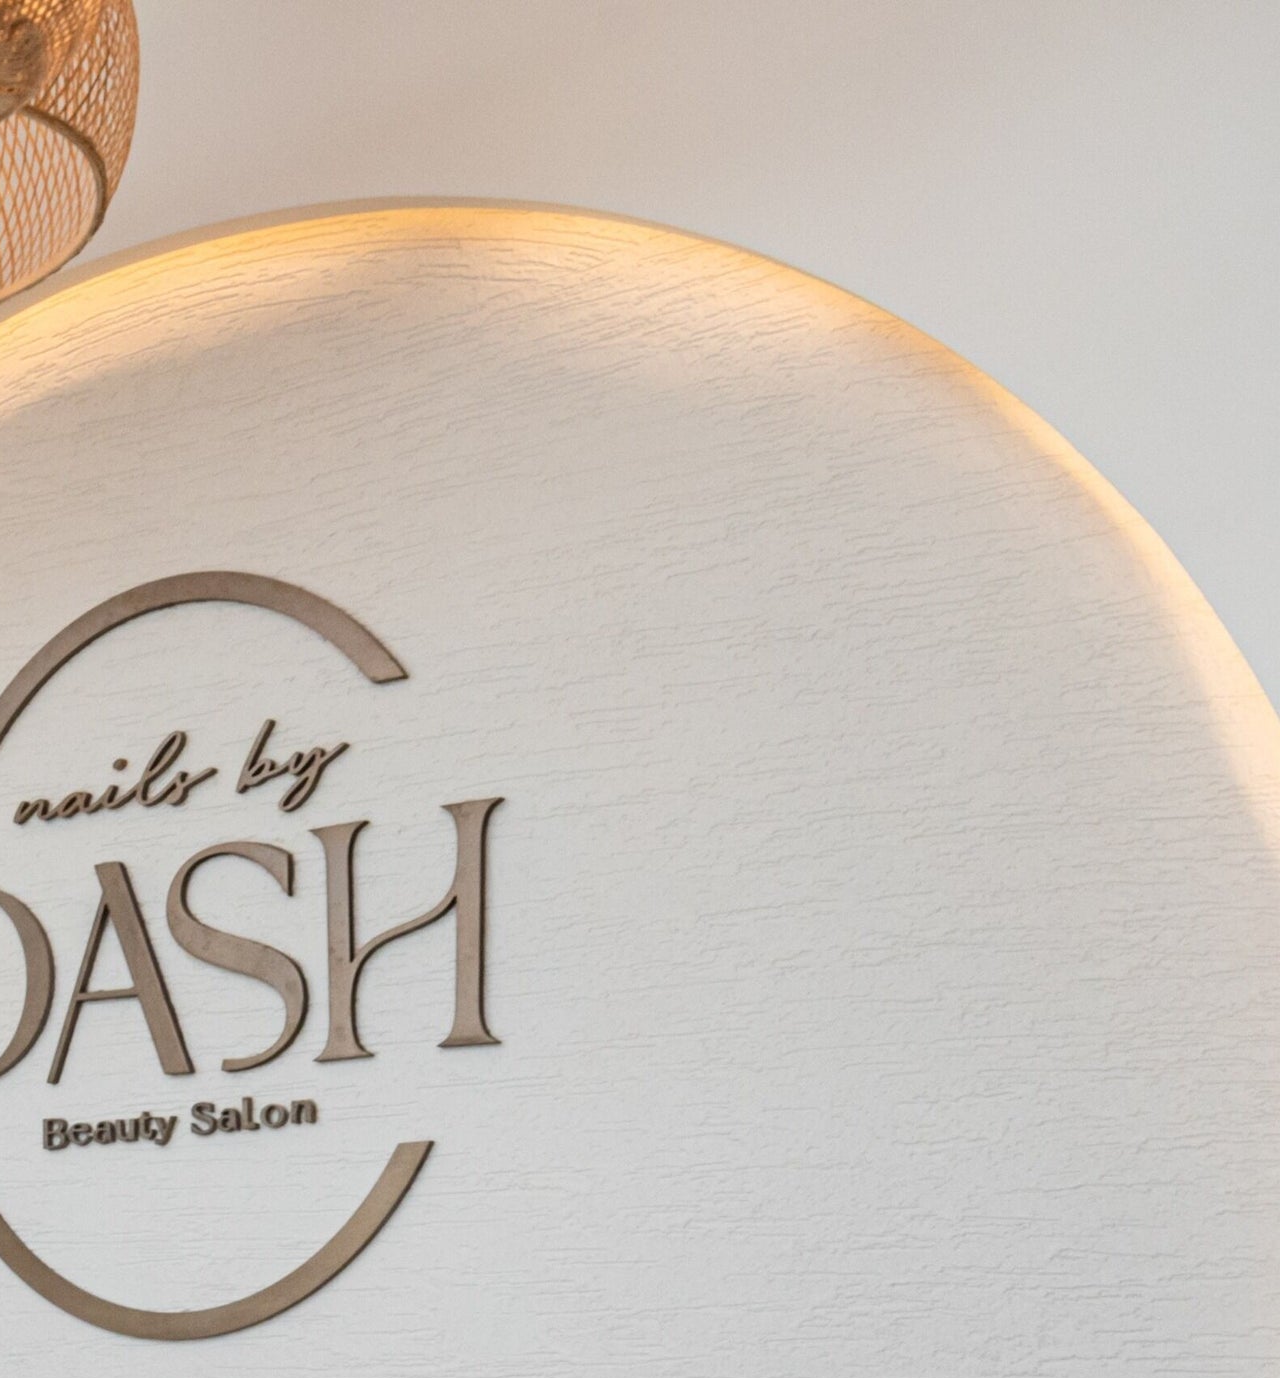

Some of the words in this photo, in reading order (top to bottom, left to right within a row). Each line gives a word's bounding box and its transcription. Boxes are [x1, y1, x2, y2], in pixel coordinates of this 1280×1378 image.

[13, 731, 218, 825] nails
[237, 718, 352, 813] by
[42, 1112, 178, 1151] Beauty
[190, 1095, 318, 1137] Salon
